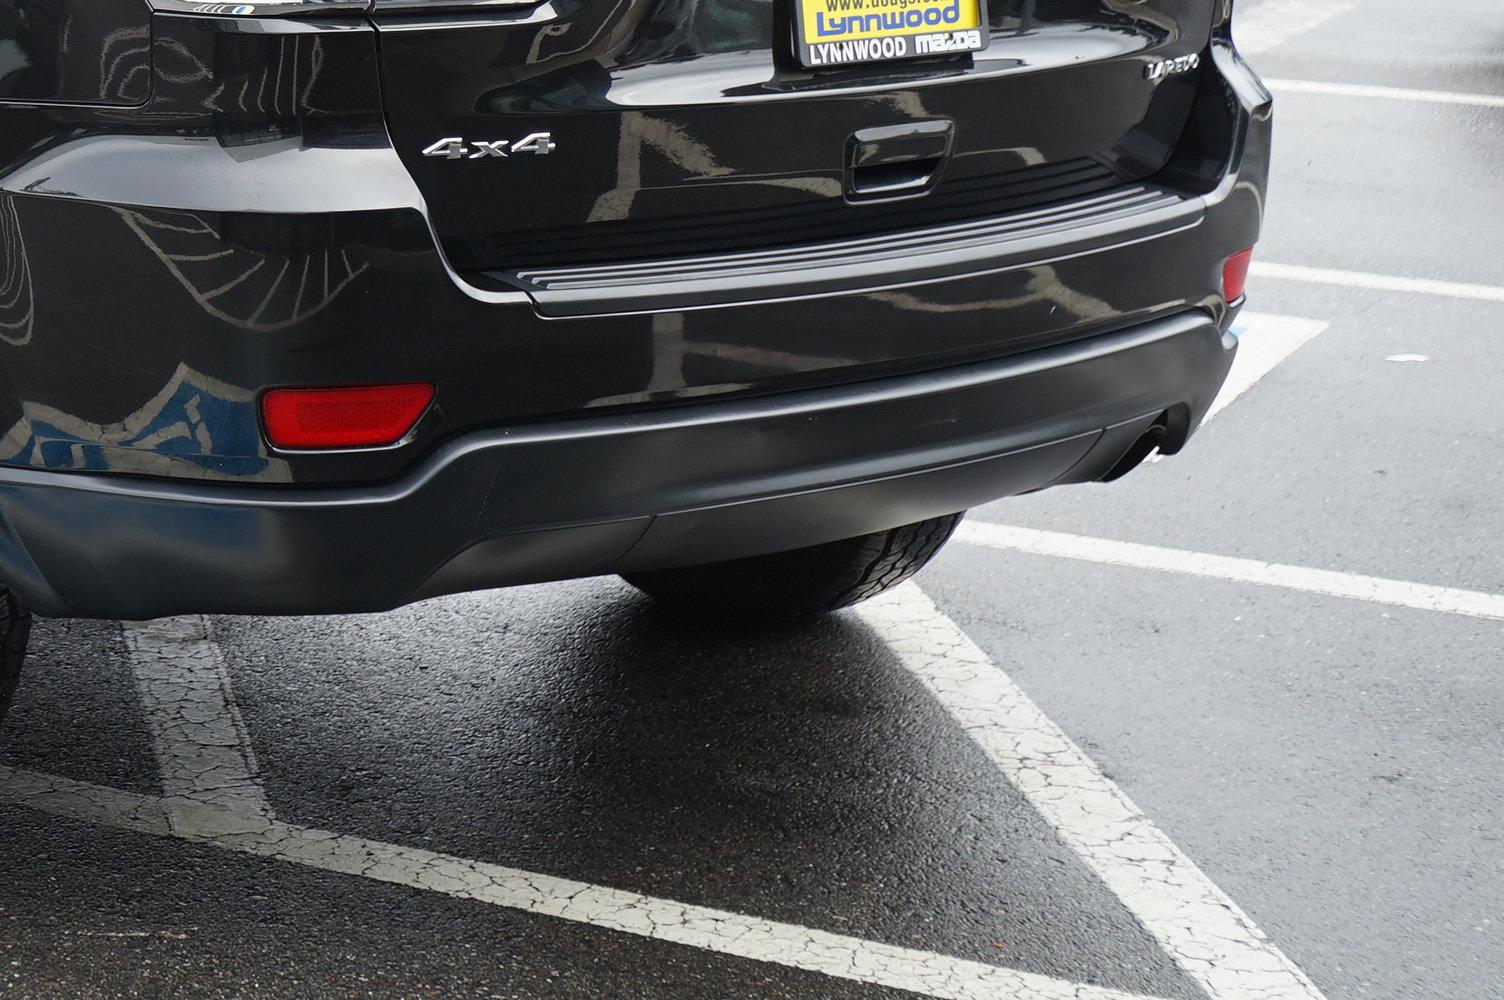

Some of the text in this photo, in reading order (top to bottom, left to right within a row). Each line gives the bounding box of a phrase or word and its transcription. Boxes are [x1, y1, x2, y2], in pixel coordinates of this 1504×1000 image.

[816, 0, 960, 36] Lynnwood
[809, 36, 907, 65] LYNNWOOD
[422, 132, 556, 160] 4x4
